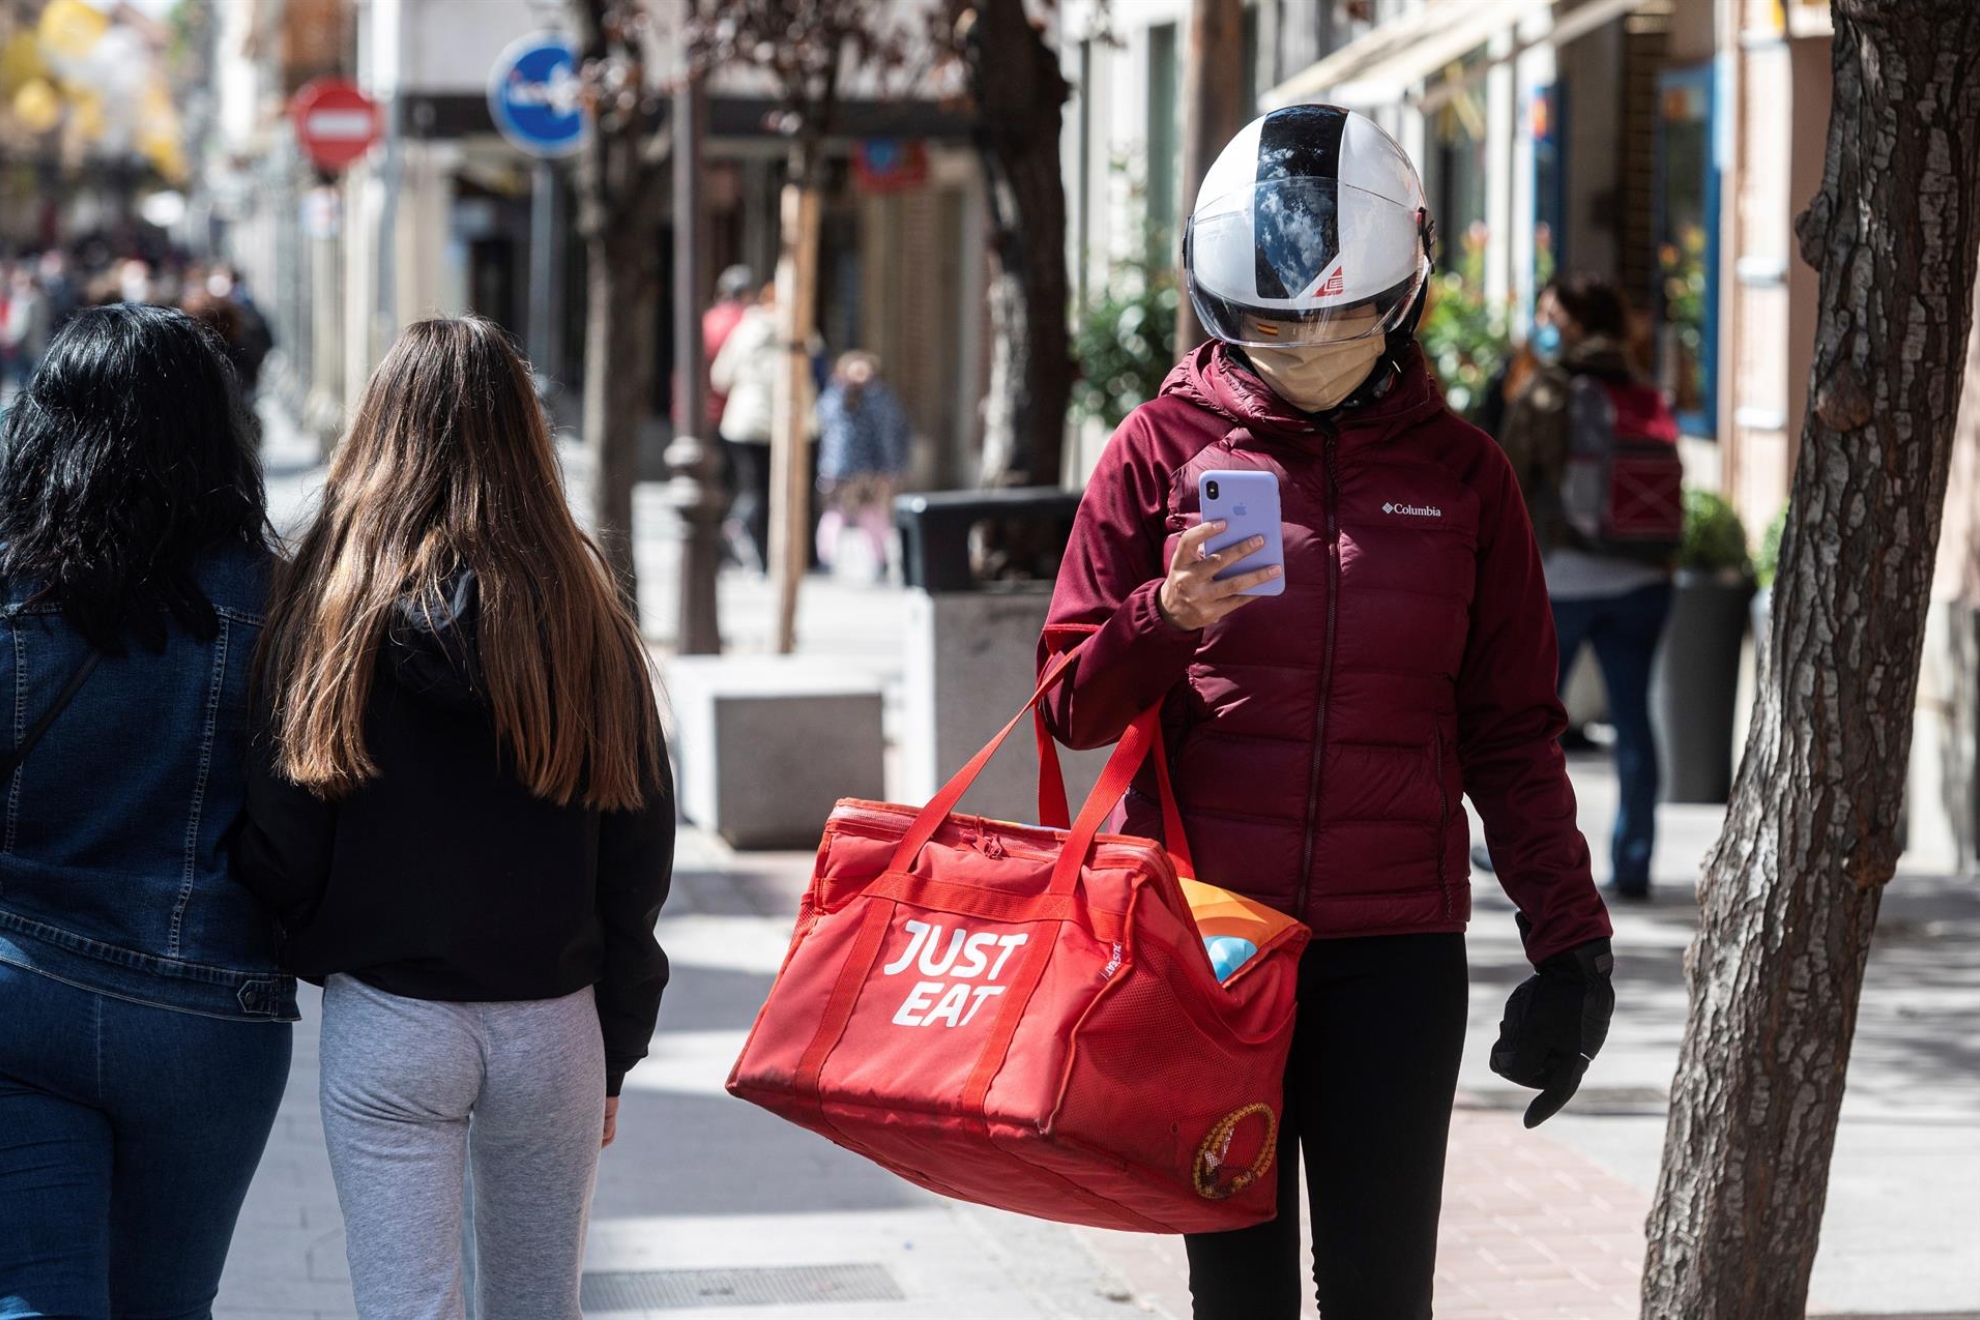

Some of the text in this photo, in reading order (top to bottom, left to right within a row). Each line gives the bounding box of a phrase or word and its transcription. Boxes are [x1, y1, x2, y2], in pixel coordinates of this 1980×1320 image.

[1393, 503, 1442, 517] Columbia
[883, 919, 1029, 981] JUST
[1112, 941, 1122, 965] JUS
[891, 980, 1007, 1028] EAT
